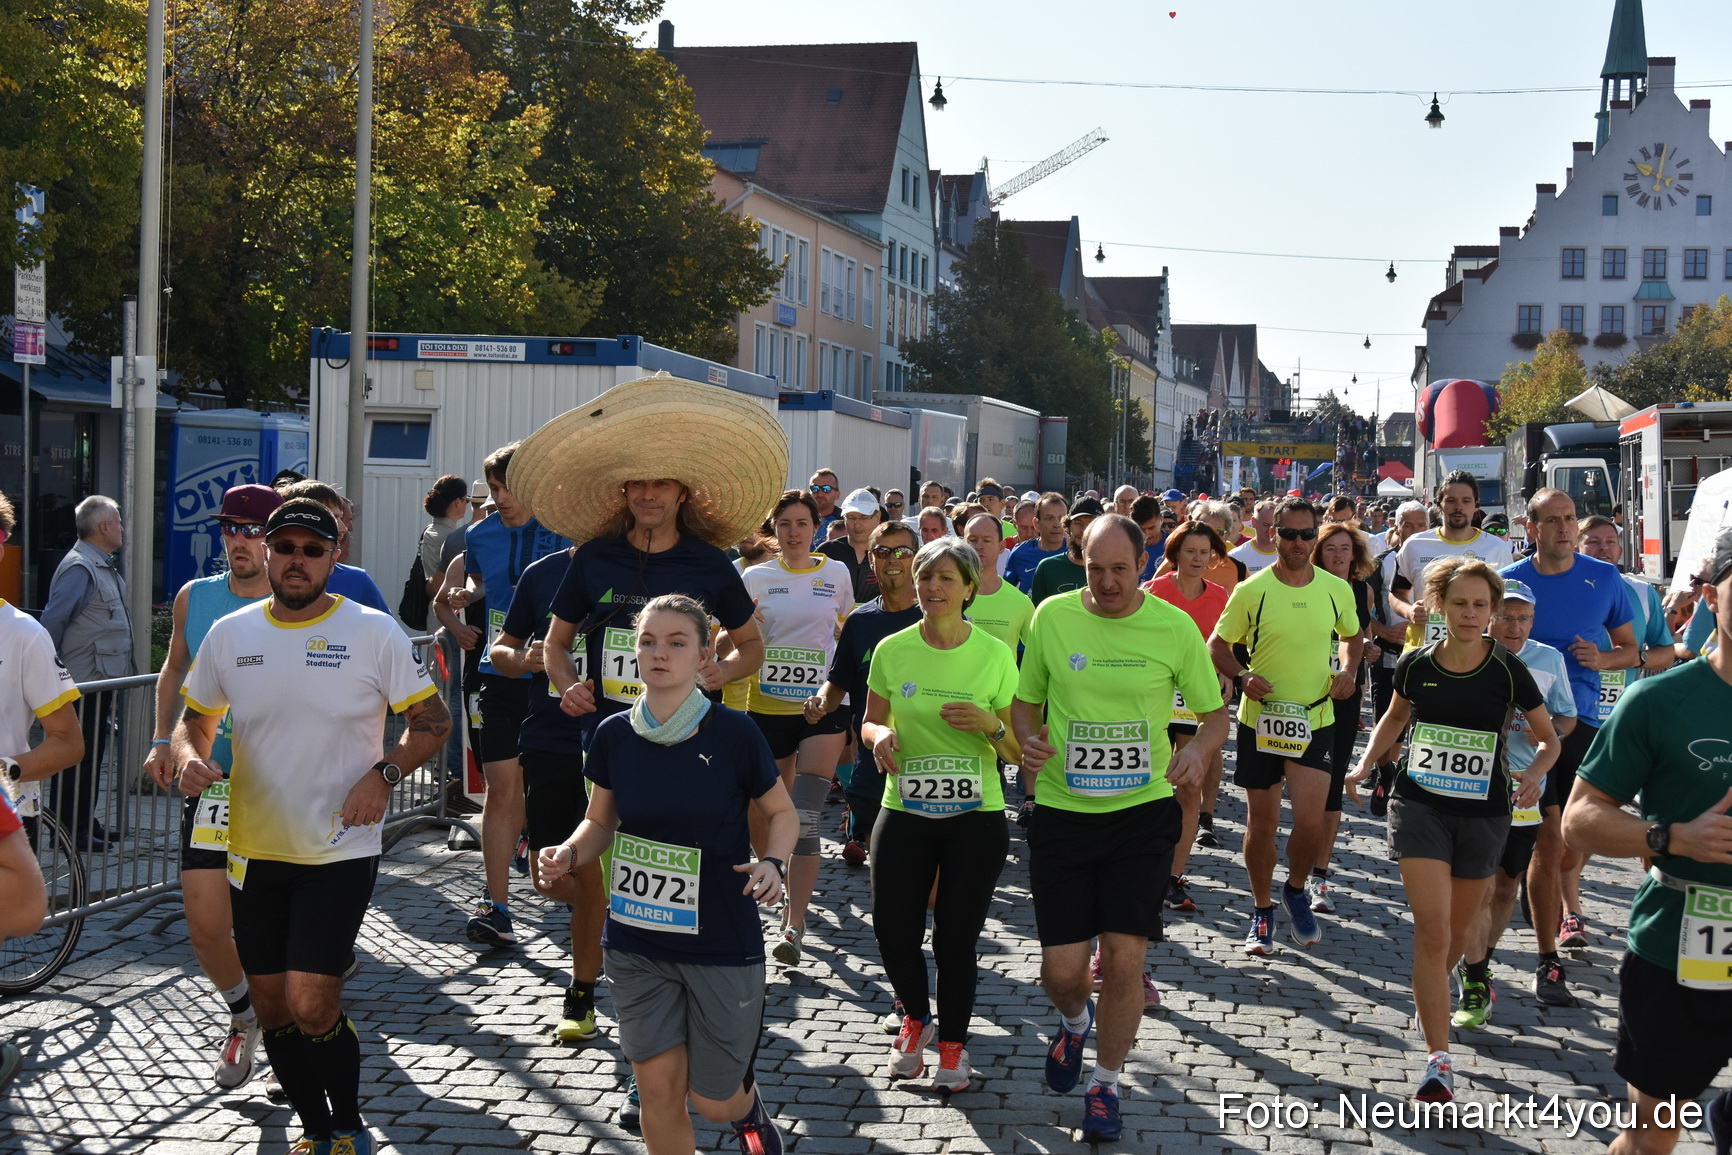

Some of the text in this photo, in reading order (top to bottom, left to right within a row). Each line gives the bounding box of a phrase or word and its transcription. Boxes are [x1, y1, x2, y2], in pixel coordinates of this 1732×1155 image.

[198, 435, 220, 445] 08141
[227, 437, 241, 446] 536
[243, 438, 252, 446] 80
[1258, 446, 1297, 456] START
[285, 512, 321, 522] orca
[308, 639, 327, 651] 20
[237, 656, 264, 664] BOCK
[306, 652, 351, 660] Neumarkter
[766, 649, 820, 664] BOCK
[306, 660, 342, 669] Stadtlauf
[767, 665, 818, 684] 2292
[770, 687, 813, 697] CLAUDIA
[1264, 703, 1306, 718] BOCK
[1073, 723, 1142, 740] BOCK
[1263, 718, 1306, 740] 1089
[1268, 739, 1303, 751] ROLAND
[1419, 727, 1488, 750] BOCK
[905, 757, 974, 774] BOCK
[1074, 747, 1141, 770] 2233
[1418, 748, 1484, 776] 2180
[908, 778, 973, 799] 2238
[1073, 776, 1143, 788] CHRISTIAN
[1415, 774, 1481, 791] CHRISTINE
[922, 803, 962, 812] PETRA
[619, 837, 691, 871] BOCK
[618, 866, 686, 904] 2072
[624, 902, 674, 922] MAREN
